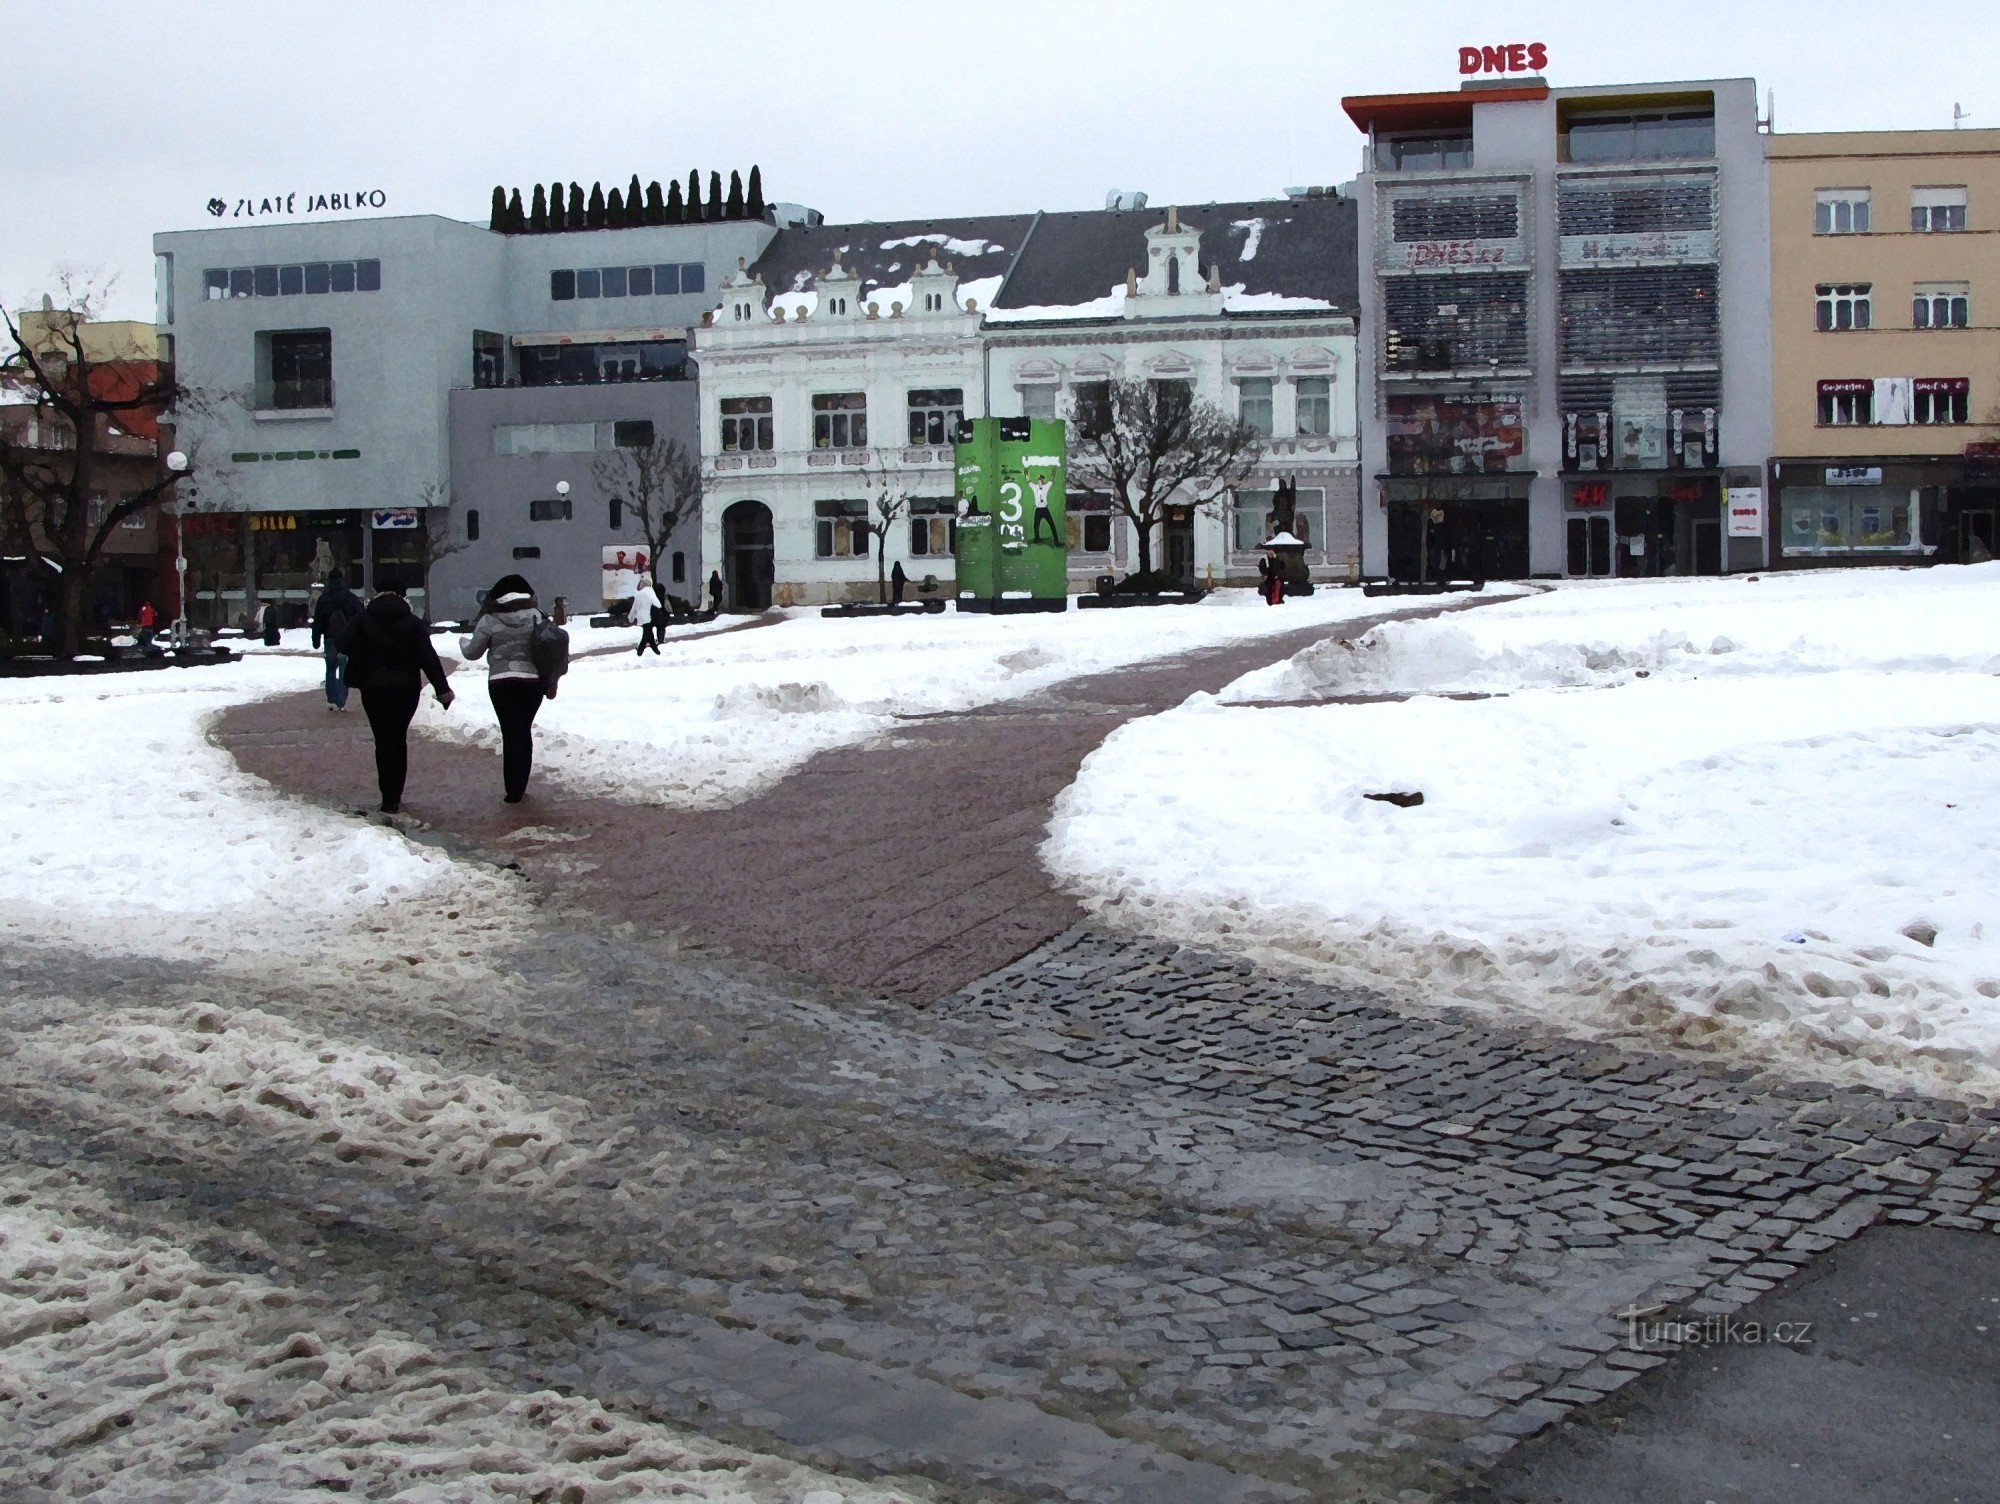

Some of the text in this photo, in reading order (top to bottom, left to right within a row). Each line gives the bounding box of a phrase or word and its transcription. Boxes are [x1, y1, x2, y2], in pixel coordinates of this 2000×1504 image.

[1458, 42, 1548, 75] DNES
[233, 189, 387, 218] ZLATÉ JABLKO
